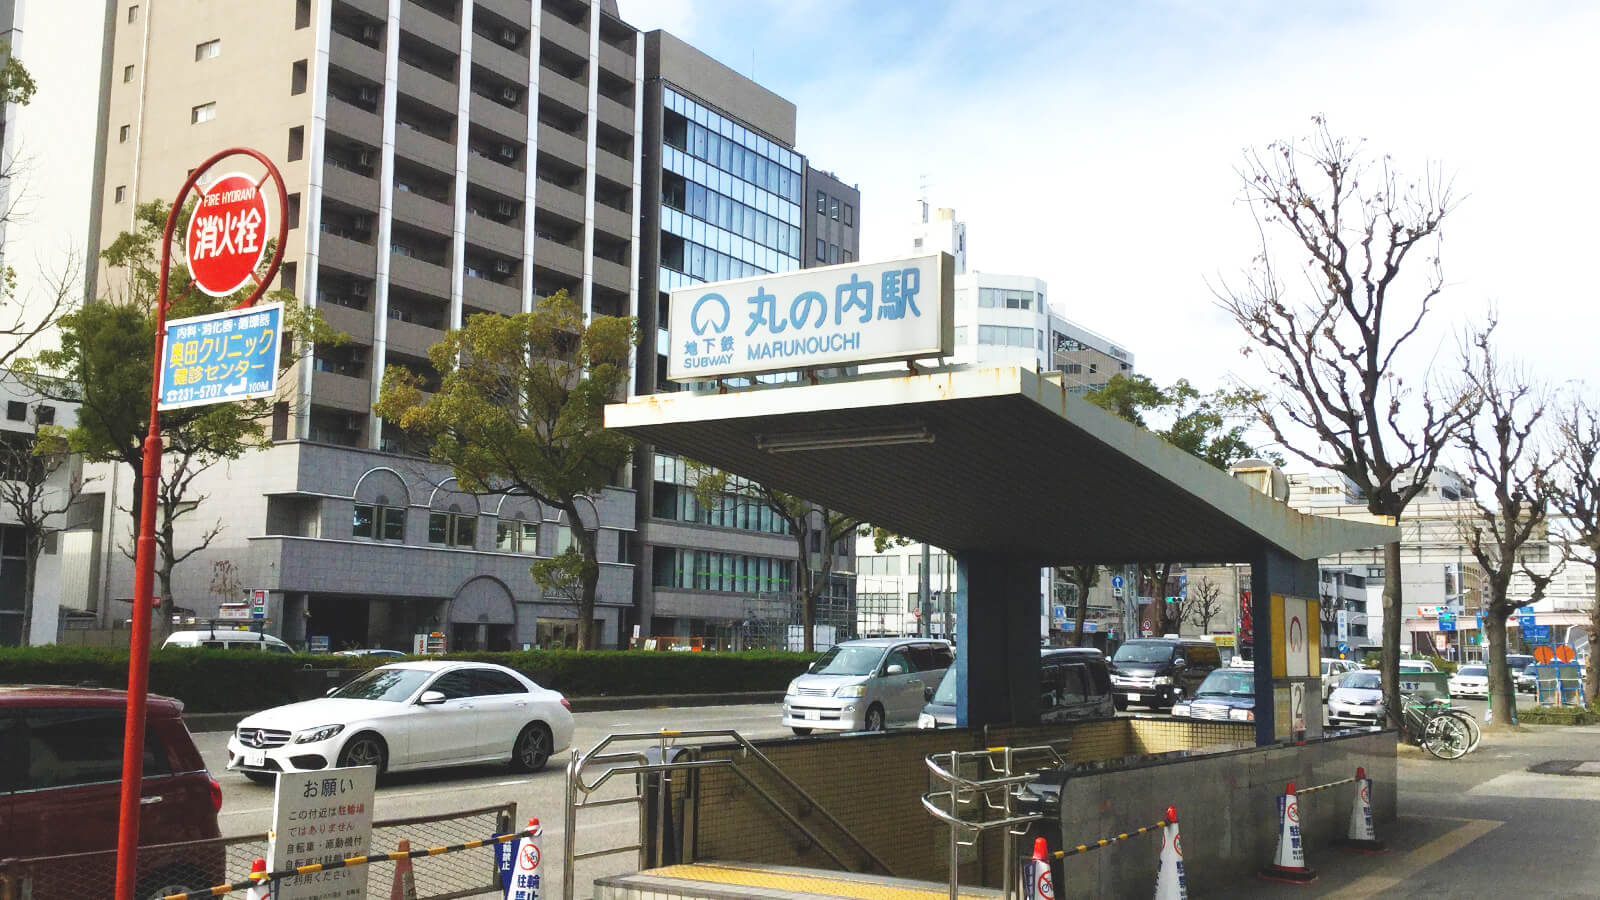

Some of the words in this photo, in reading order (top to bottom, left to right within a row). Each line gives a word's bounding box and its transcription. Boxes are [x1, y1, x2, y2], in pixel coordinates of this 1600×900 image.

[204, 193, 220, 207] FIRE
[222, 187, 255, 204] HYDRANT
[195, 208, 262, 259] 消火栓
[745, 267, 920, 336] 丸の内駅
[170, 329, 274, 368] 奥田クリニック
[684, 335, 735, 356] 地下鉄
[747, 332, 860, 360] MARUNOUCHI
[684, 354, 733, 369] SUBWAY
[249, 381, 269, 392] 100M
[1295, 685, 1302, 718] 2
[303, 778, 354, 798] お願い
[288, 823, 353, 837] ではありません
